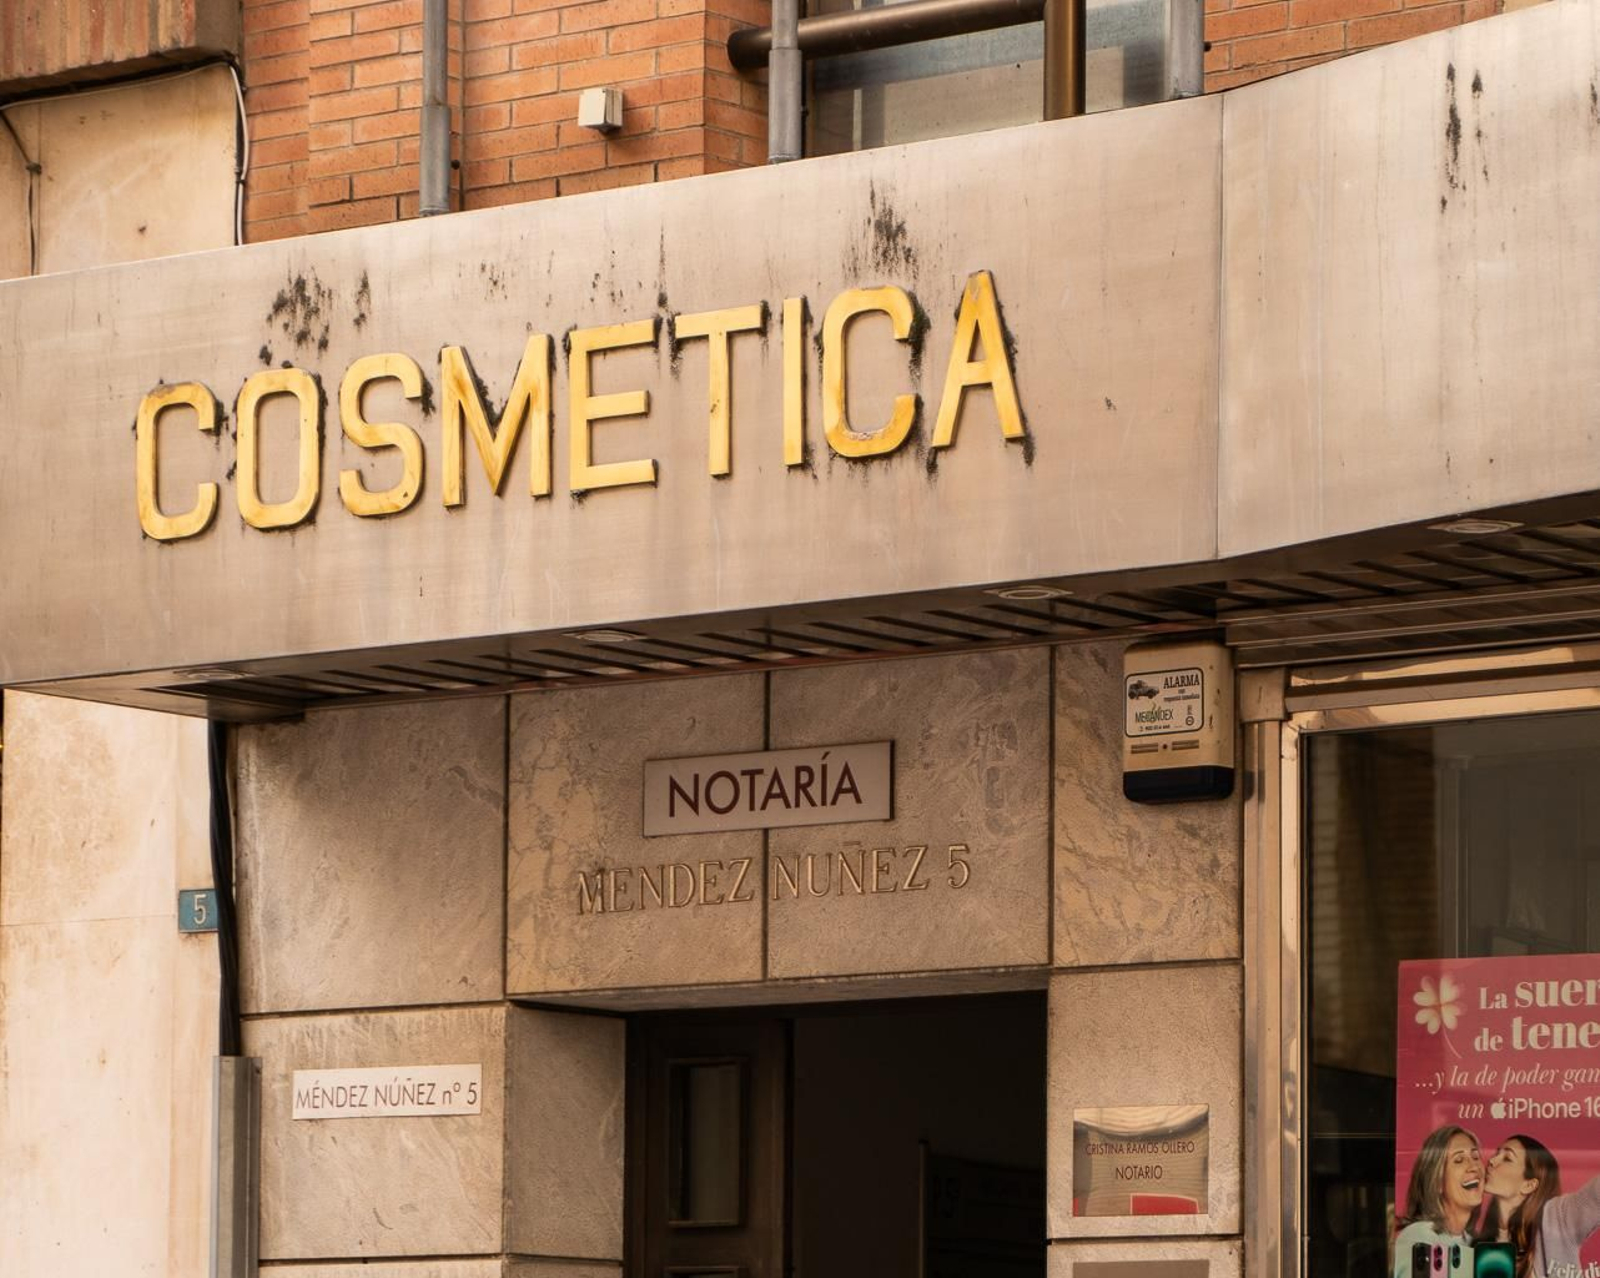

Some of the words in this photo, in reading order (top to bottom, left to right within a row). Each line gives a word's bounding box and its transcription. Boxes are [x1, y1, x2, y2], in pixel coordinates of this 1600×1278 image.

[135, 269, 1027, 541] COSMETICA
[1163, 674, 1200, 690] ALARMA
[668, 751, 863, 818] NOTARÍA
[576, 857, 756, 915] MENDEZ
[771, 840, 931, 901] NUÑEZ
[946, 844, 972, 889] 5
[193, 893, 207, 925] 5
[1478, 986, 1508, 1010] La
[1514, 977, 1600, 1008] suer
[1473, 1027, 1503, 1051] de
[1511, 1016, 1600, 1050] tene
[295, 1080, 369, 1110] MÉNDEZ
[373, 1076, 437, 1107] NÚÑEZ
[466, 1081, 478, 1105] 5
[1449, 1065, 1469, 1086] la
[1474, 1064, 1498, 1086] de
[1500, 1062, 1559, 1093] poder
[1457, 1101, 1485, 1119] un
[1508, 1097, 1581, 1119] iPhone
[1086, 1141, 1125, 1156] CRISTINA
[1126, 1141, 1159, 1155] RAMOS
[1162, 1140, 1195, 1154] OLLERO
[1115, 1164, 1163, 1180] NOTARIO
